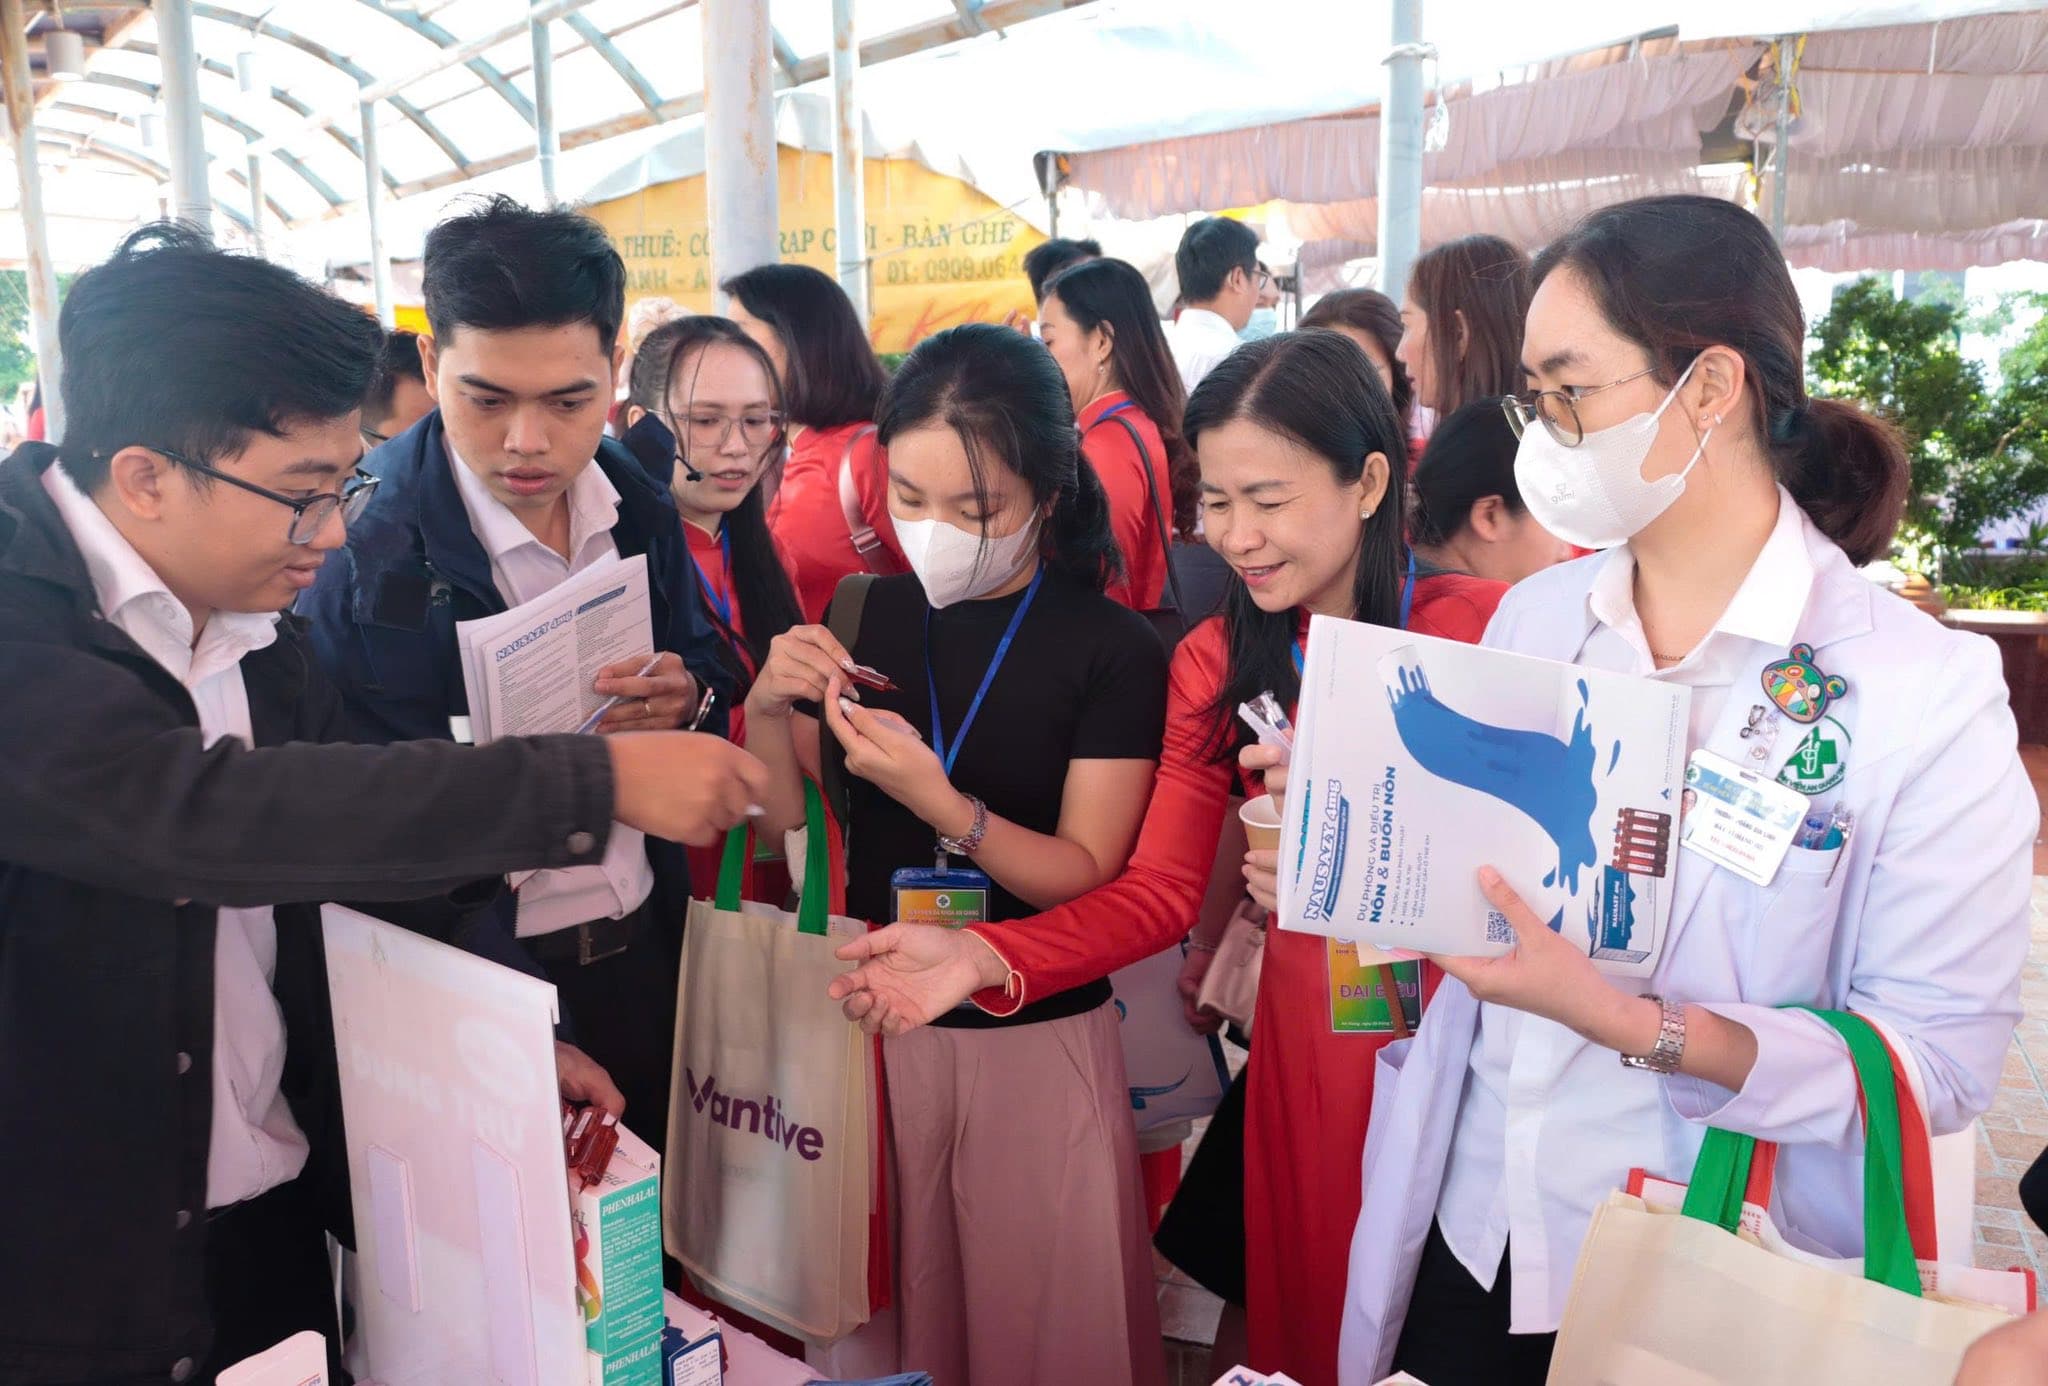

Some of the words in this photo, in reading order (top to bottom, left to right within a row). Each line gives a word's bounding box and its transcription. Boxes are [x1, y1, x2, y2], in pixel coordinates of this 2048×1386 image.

[1382, 765, 1397, 806] NÔN
[1304, 822, 1336, 920] NAUSAZY
[1325, 779, 1342, 821] 4mg
[1377, 866, 1390, 880] &
[1369, 884, 1387, 923] NÔN
[686, 1066, 825, 1161] Vantive
[602, 1186, 656, 1217] PHENHALAL
